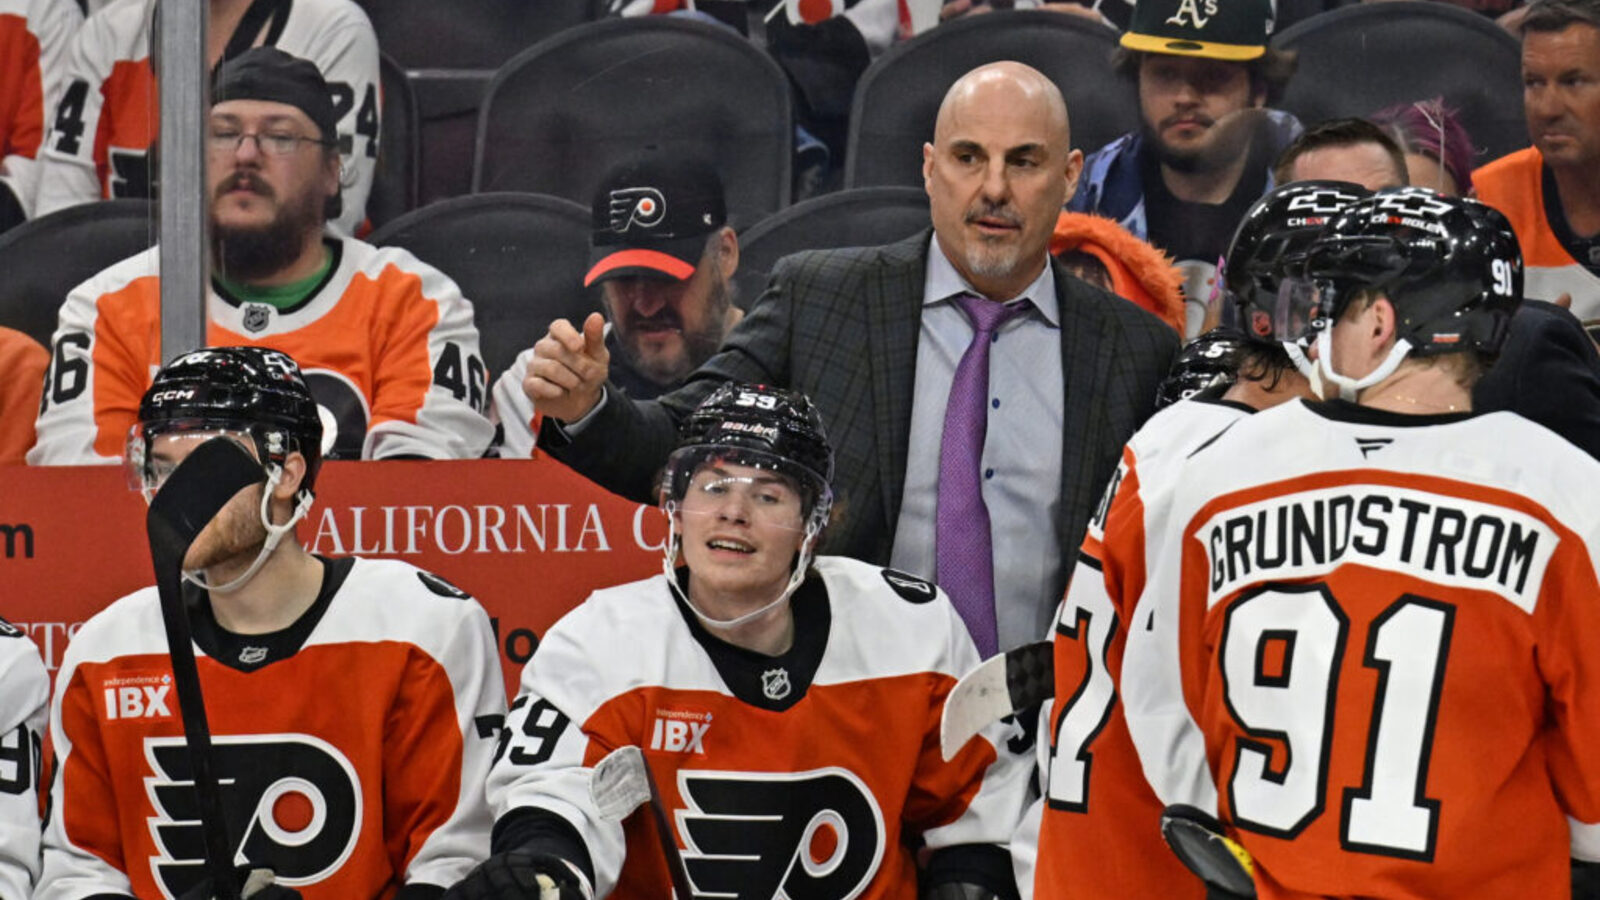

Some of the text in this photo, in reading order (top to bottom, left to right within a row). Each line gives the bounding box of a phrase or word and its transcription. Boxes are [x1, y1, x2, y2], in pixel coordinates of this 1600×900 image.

[1492, 258, 1512, 297] 91
[433, 341, 485, 414] 46
[152, 390, 194, 407] CCM
[736, 392, 777, 410] 59
[303, 503, 613, 555] ALIFORNIA
[1209, 495, 1539, 595] GRUNDSTROM
[104, 686, 172, 720] IBX
[1220, 580, 1457, 863] 91
[650, 718, 711, 754] IBX
